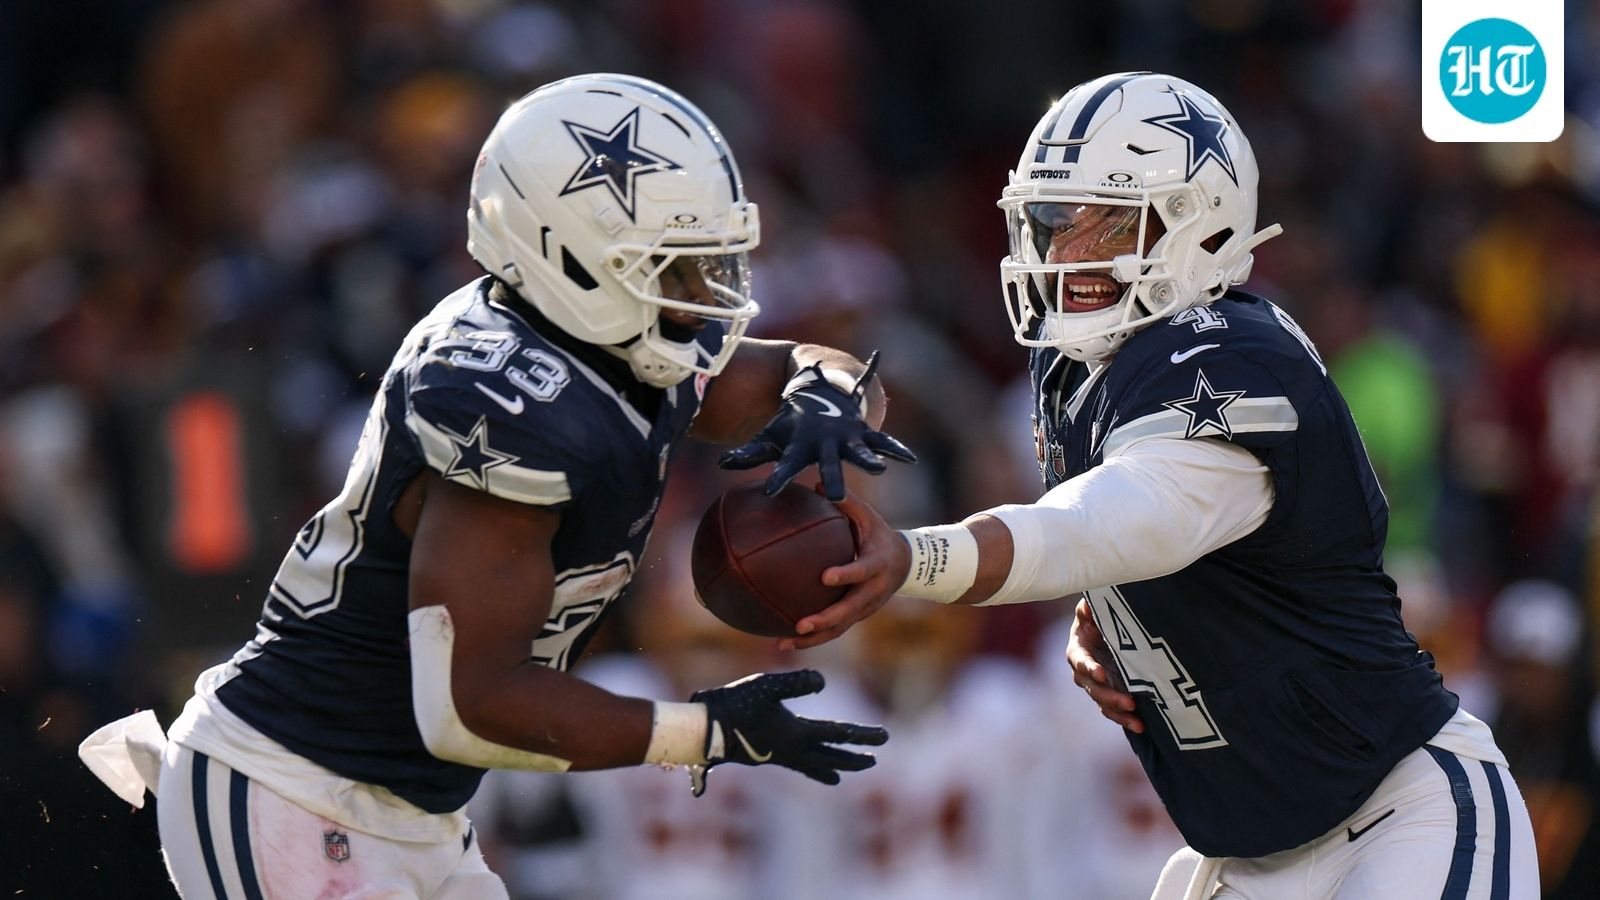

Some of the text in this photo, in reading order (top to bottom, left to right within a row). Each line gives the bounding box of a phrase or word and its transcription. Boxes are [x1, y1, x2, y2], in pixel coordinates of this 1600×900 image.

[1030, 169, 1071, 180] COWBOYS
[1168, 305, 1229, 334] 4
[449, 329, 571, 402] 33
[1081, 585, 1230, 751] 4
